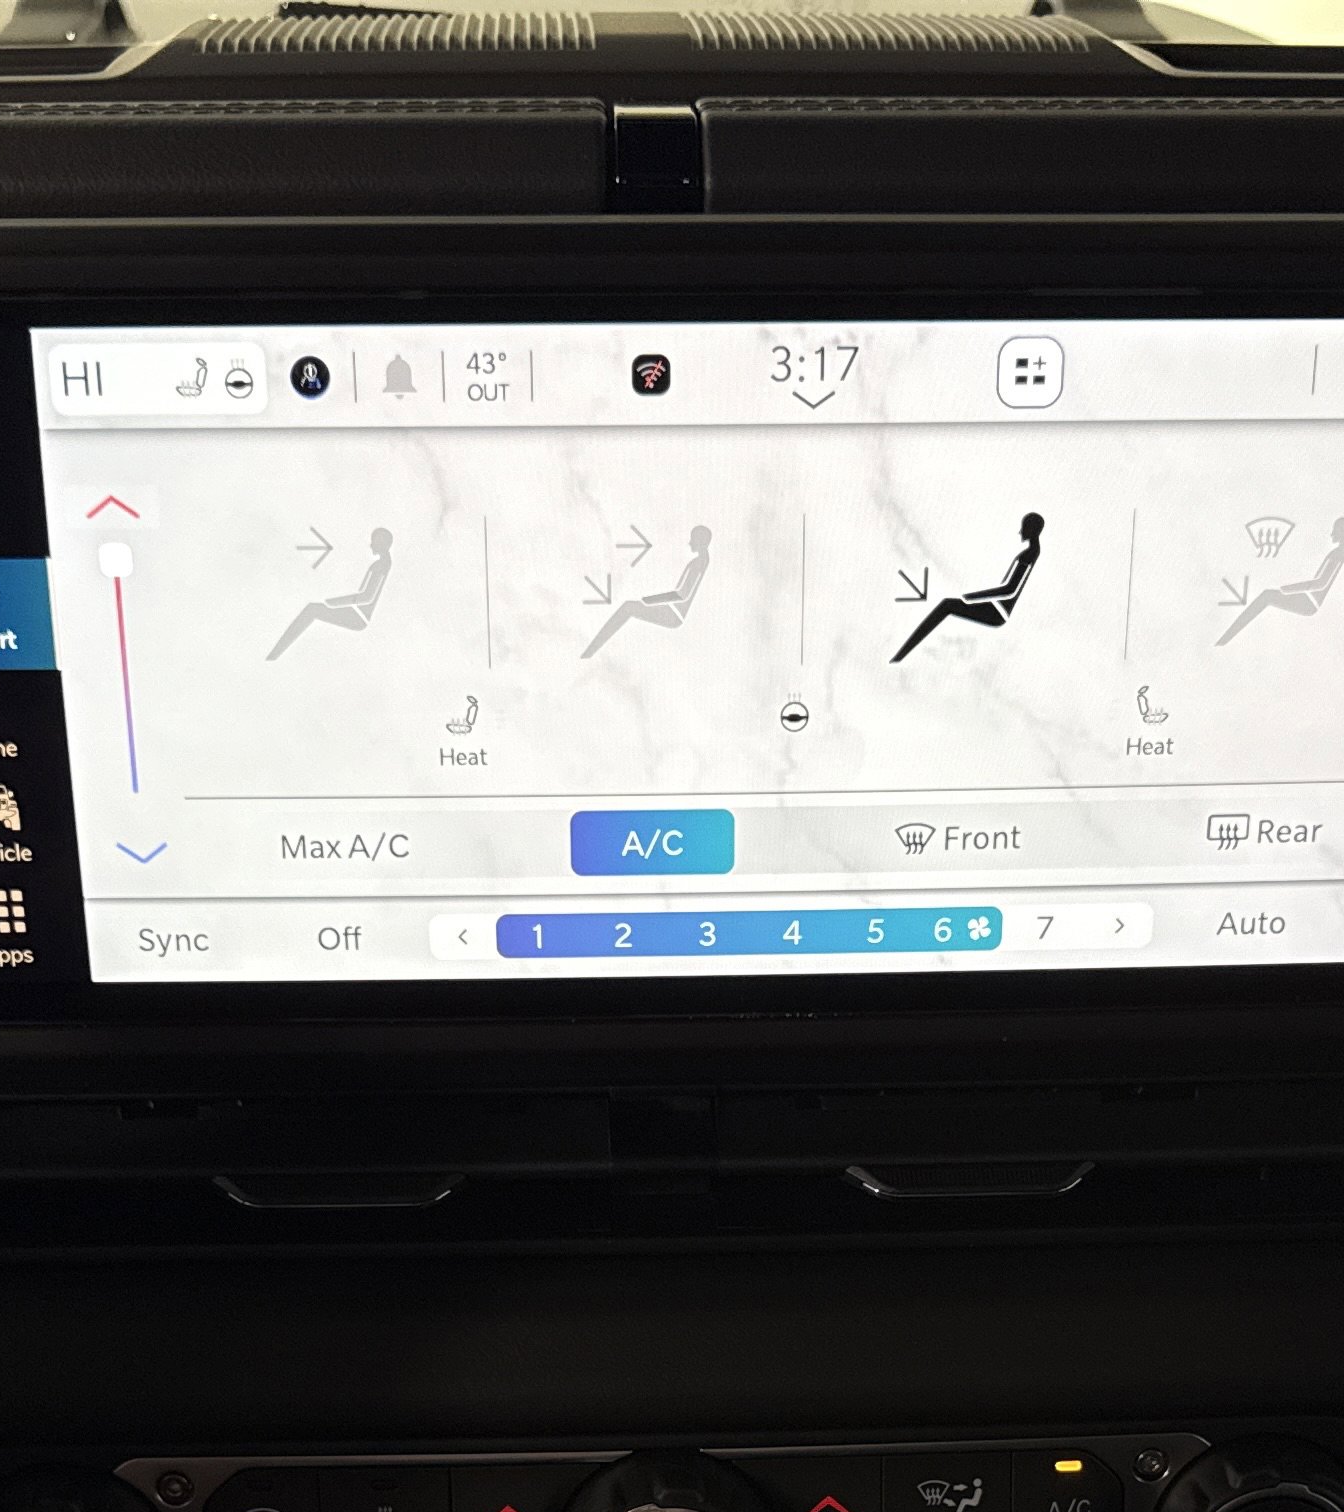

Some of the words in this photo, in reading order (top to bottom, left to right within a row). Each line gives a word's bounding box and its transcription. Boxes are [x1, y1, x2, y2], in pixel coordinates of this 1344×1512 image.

[465, 352, 508, 375] 43°
[769, 345, 862, 384] 3:17
[62, 361, 104, 397] HI
[466, 383, 510, 402] OUT
[439, 746, 488, 767] Heat
[1126, 735, 1175, 757] Heat
[621, 826, 685, 858] A/C
[944, 820, 1022, 851] Front
[1257, 813, 1323, 844] Rear
[281, 834, 341, 860] Max
[347, 832, 411, 861] A/C
[532, 924, 544, 949] 1
[613, 922, 633, 946] 2
[698, 921, 717, 947] 3
[781, 920, 802, 945] 4
[866, 918, 885, 943] 5
[933, 917, 953, 943] 6
[1036, 915, 1055, 941] 7
[1216, 908, 1287, 936] Auto
[139, 926, 210, 954] Sync
[317, 925, 362, 951] Off
